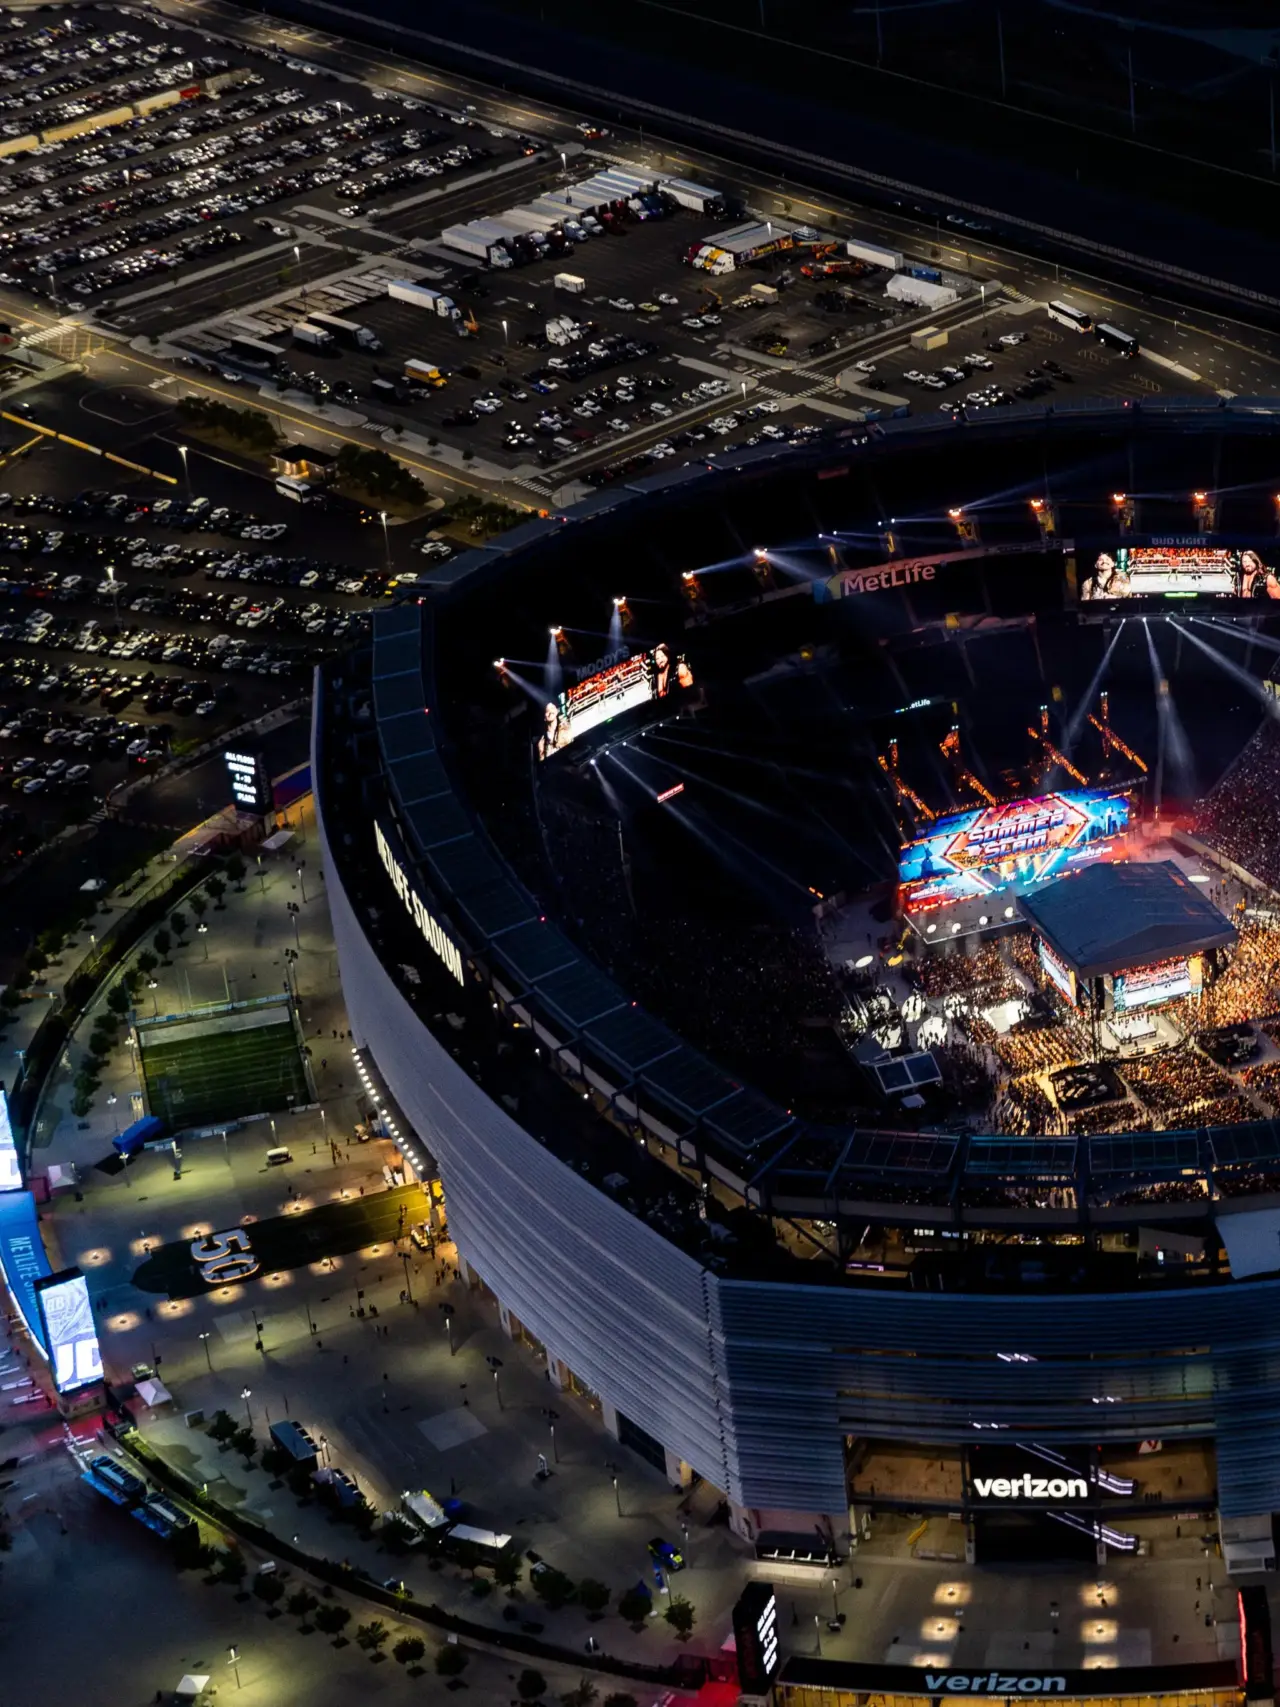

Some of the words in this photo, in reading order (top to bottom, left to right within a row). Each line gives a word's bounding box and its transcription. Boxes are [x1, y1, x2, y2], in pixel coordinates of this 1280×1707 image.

[1151, 537, 1174, 546] BUD
[1175, 537, 1208, 546] LIGHT
[843, 562, 936, 596] MetLife
[967, 813, 1065, 846] SUMMER
[984, 832, 1048, 860] SLAM
[411, 890, 464, 987] STADIUM
[8, 1236, 42, 1280] METLIFE
[190, 1228, 260, 1284] 50
[973, 1473, 1088, 1499] verizon
[925, 1672, 1067, 1693] verizon
